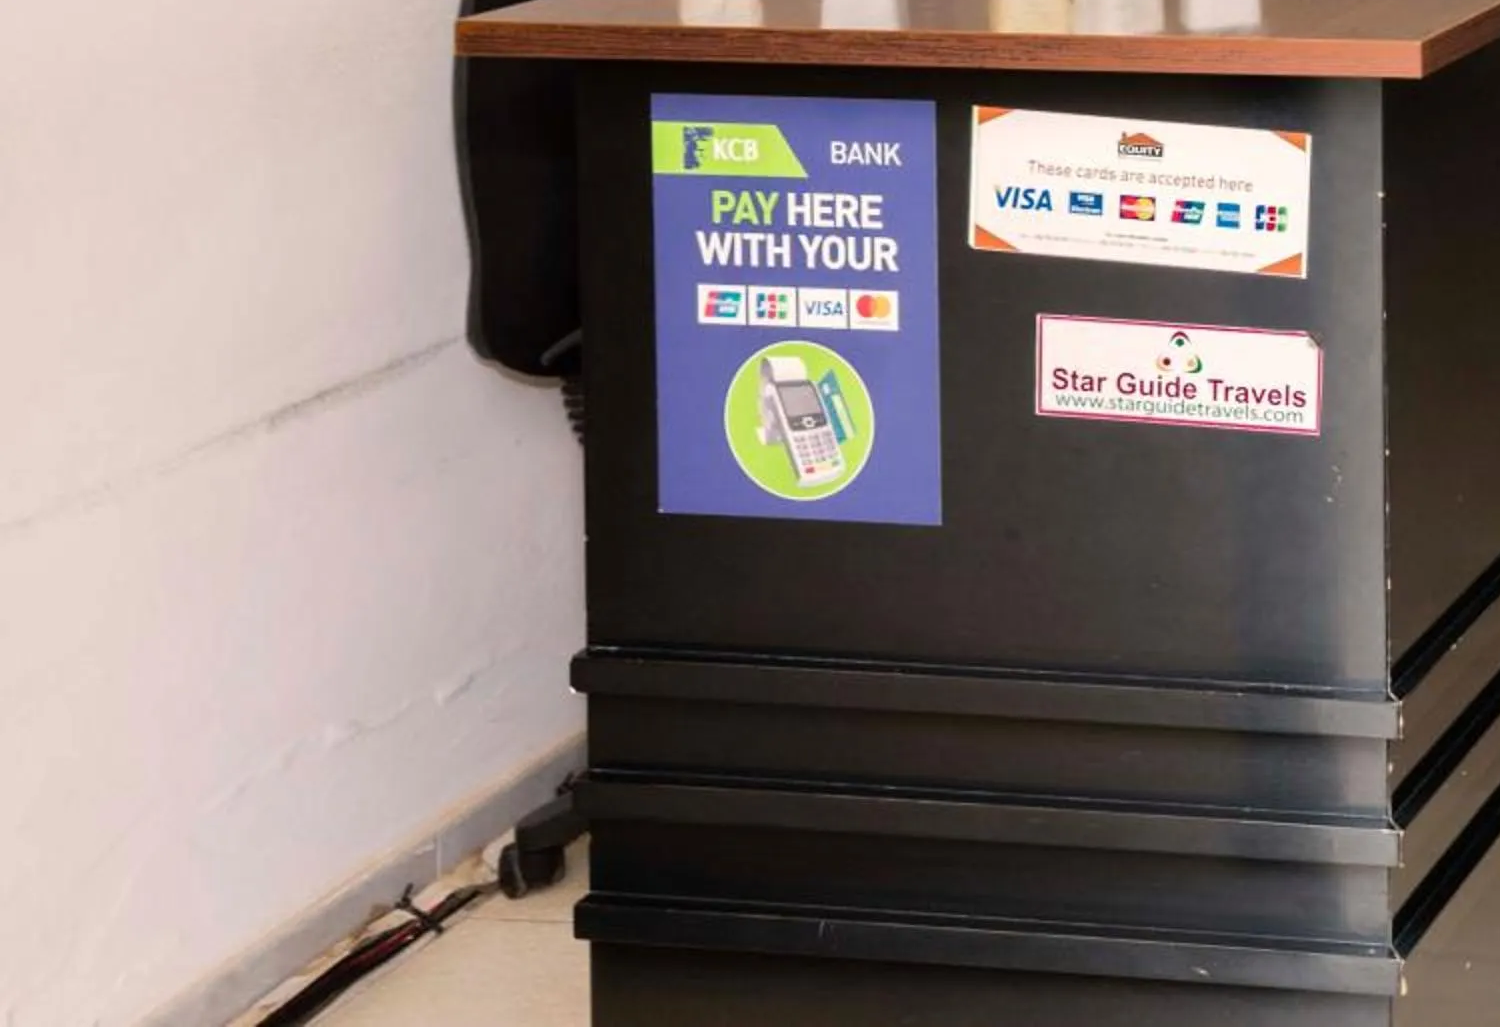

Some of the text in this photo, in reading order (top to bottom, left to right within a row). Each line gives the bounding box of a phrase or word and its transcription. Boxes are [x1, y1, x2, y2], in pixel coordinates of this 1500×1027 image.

[712, 137, 902, 167] KCB BANK
[1118, 143, 1162, 157] EQUITY
[1028, 160, 1254, 193] These cards are accepted here
[711, 190, 884, 229] PAY HERE
[994, 186, 1053, 211] VISA
[696, 230, 899, 272] WITH YOUR
[805, 300, 844, 317] VISA
[1052, 367, 1307, 408] Star Guide Travels
[1055, 393, 1305, 423] www.starguidetravels.com
